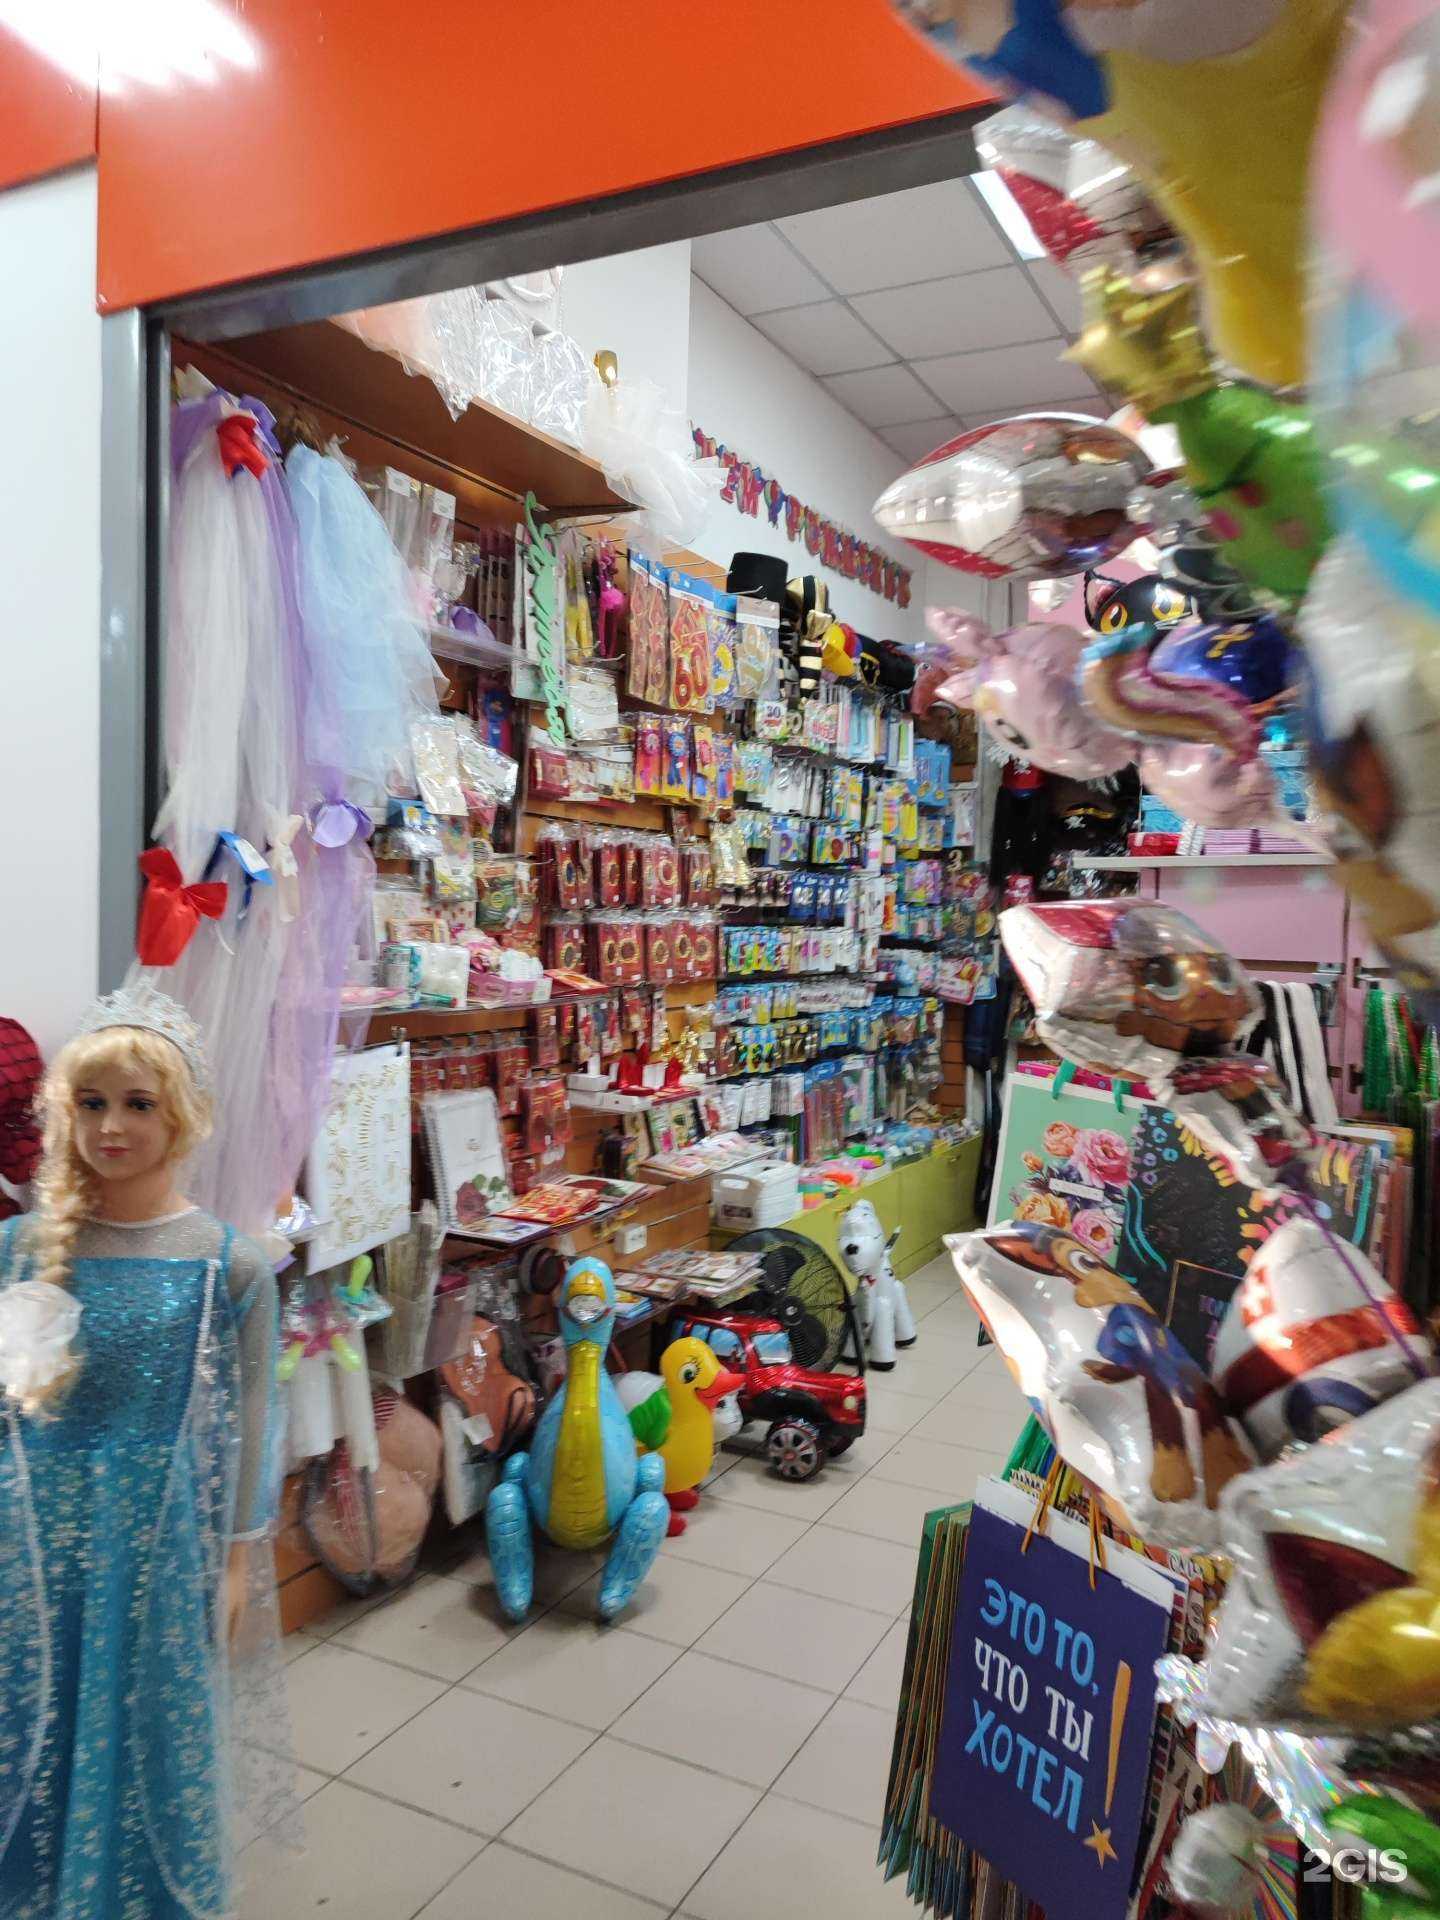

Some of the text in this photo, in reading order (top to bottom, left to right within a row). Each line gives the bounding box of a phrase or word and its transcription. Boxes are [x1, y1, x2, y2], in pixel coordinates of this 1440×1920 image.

[974, 1636, 1095, 1763] ЧТО ТЫ
[979, 1577, 1047, 1656] ЭТО
[1053, 1616, 1100, 1697] ТО,
[964, 1698, 1084, 1834] ХОТЕЛ
